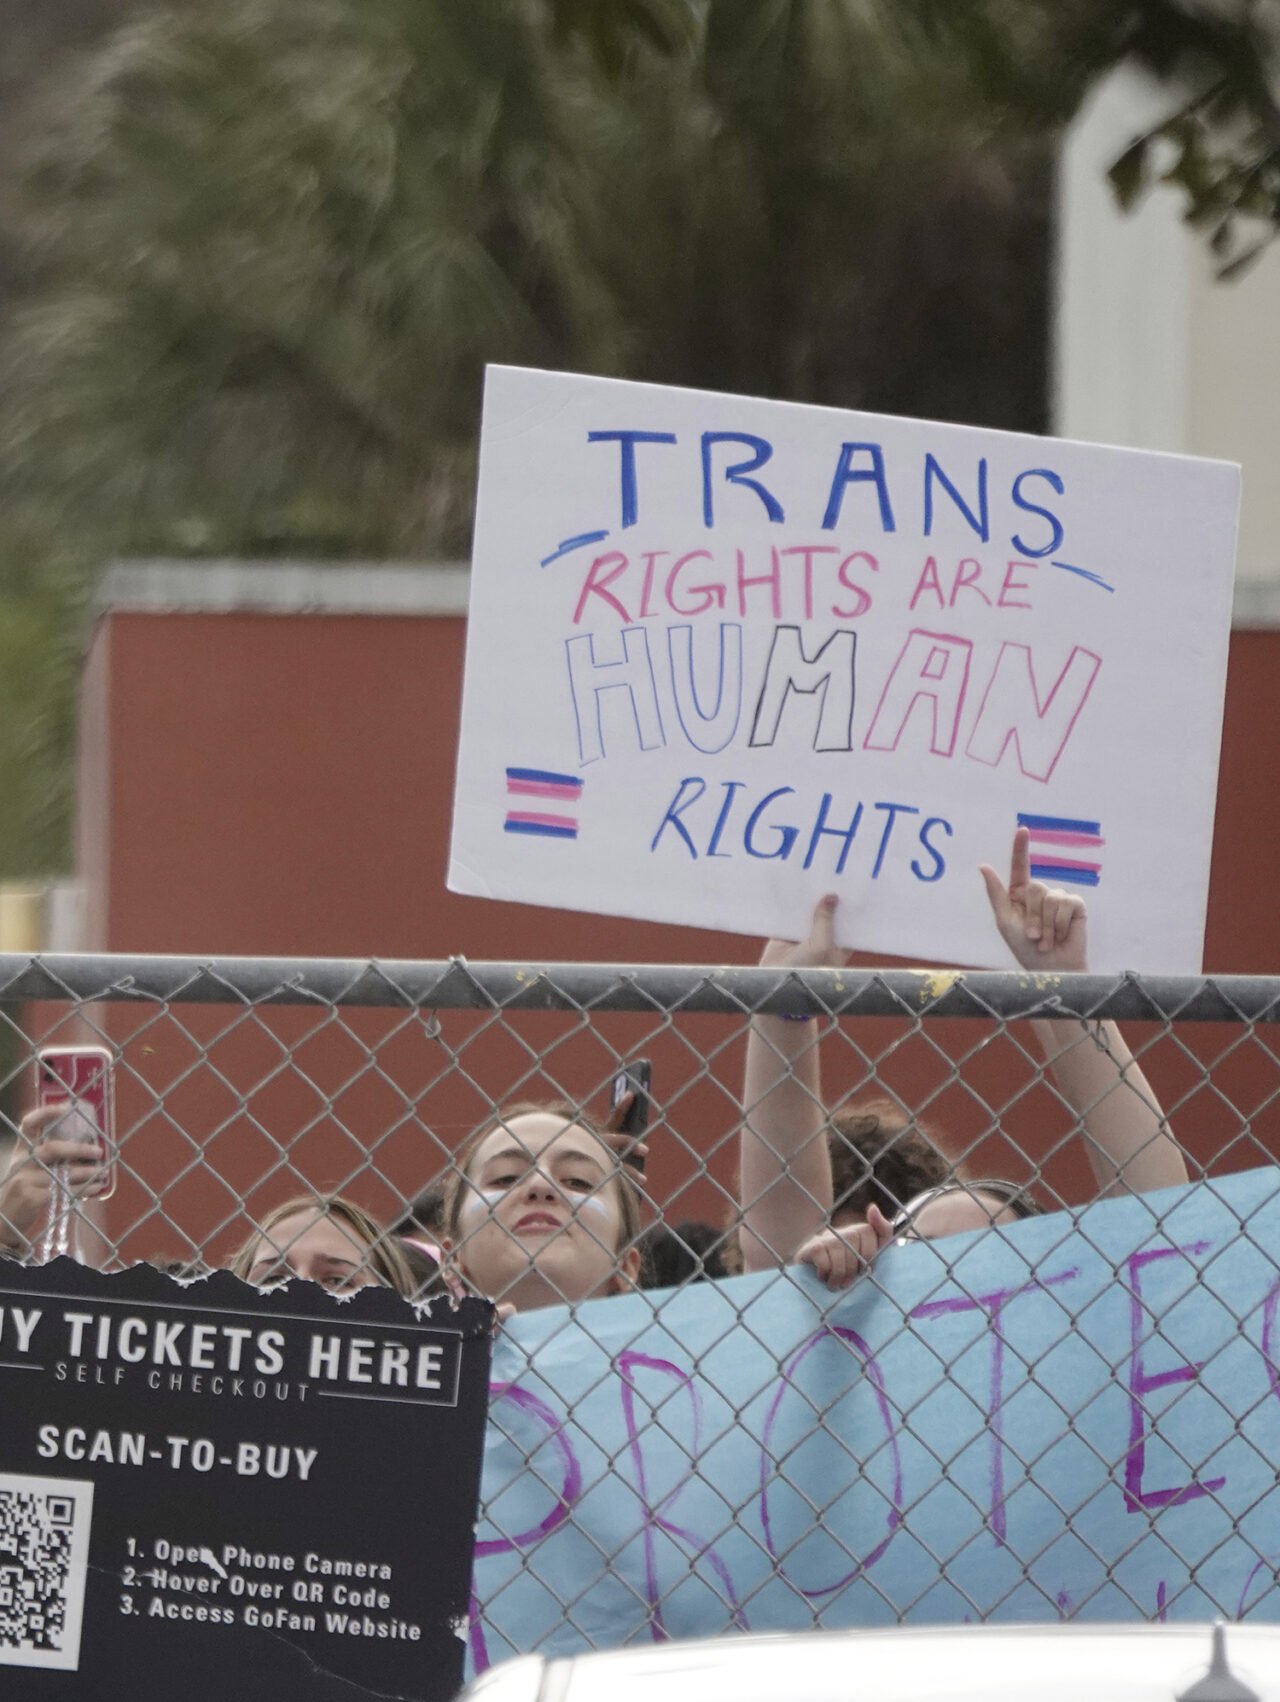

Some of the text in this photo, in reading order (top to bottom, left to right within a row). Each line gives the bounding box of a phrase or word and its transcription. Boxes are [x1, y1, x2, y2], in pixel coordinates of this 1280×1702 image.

[587, 430, 1065, 559] TRANS
[572, 546, 1038, 624] RIGHTS ARE
[564, 622, 1102, 783] HUMAN
[650, 776, 953, 882] RIGHTS
[56, 1362, 310, 1402] SELF CHECKOUT
[63, 1312, 286, 1376] TICKETS
[308, 1335, 444, 1390] HERE
[36, 1425, 319, 1481] SCAN-TO-BUY
[464, 1241, 1280, 1676] PROTE
[122, 1567, 392, 1610] 2. Hover Over QR Code
[127, 1538, 144, 1558] 1.
[223, 1545, 296, 1572] Phone
[304, 1553, 393, 1580] Camera
[120, 1595, 422, 1641] 3. Access GoFan Website
